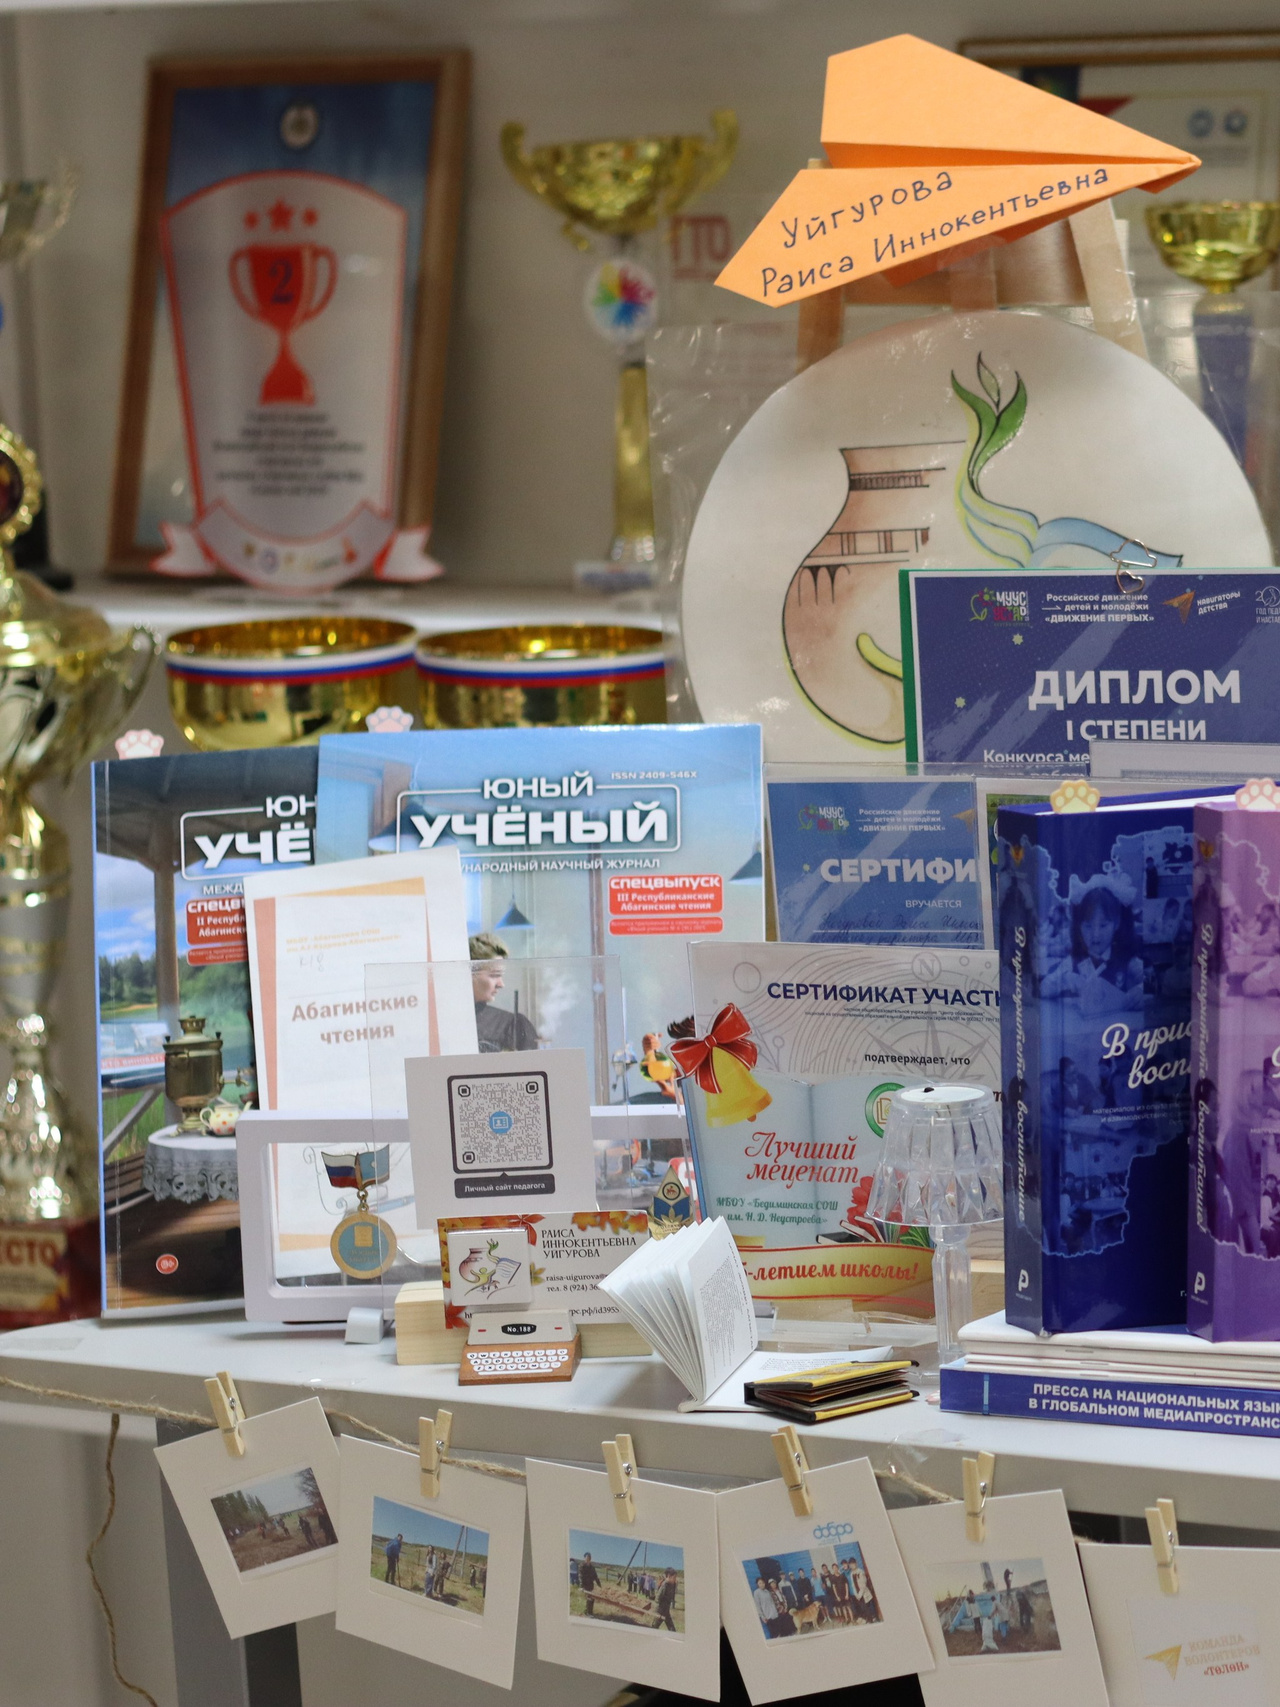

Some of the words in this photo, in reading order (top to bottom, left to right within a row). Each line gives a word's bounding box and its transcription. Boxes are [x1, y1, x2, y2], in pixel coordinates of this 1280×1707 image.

[781, 170, 953, 249] Уйгурова
[761, 252, 855, 298] Раиса
[873, 167, 1109, 263] Иннокентьевна
[269, 259, 293, 305] 2
[1046, 593, 1100, 602] Российское
[1101, 594, 1149, 602] движение
[1064, 603, 1092, 611] детей
[1101, 603, 1149, 611] молодёжи
[1045, 614, 1106, 624] «ДВИЖЕНИЕ
[1107, 613, 1155, 623] ПЕРВЫХ»
[1198, 602, 1229, 615] ДЕТСТВА
[1028, 669, 1241, 711] ДИПЛОМ
[1066, 720, 1074, 741] I
[1080, 719, 1207, 742] СТЕПЕНИ
[983, 749, 1064, 763] Конкурса
[482, 770, 594, 801] ЮНЫЙ
[610, 771, 636, 780] ISSN
[409, 801, 669, 849] УЧЁНЫЙ
[194, 821, 315, 869] УЧЁ
[540, 857, 604, 872] НАУЧНЫЙ
[606, 858, 661, 870] ЖУРНАЛ
[617, 892, 629, 902] III
[631, 892, 715, 903] Республиканские
[620, 902, 676, 911] Абагинские
[678, 902, 712, 910] чтения
[905, 899, 962, 908] ВРУЧАЕТСЯ
[1013, 926, 1027, 948] В
[1200, 923, 1213, 946] В
[766, 982, 919, 1006] СЕРТИФИКАТ
[291, 993, 419, 1022] Абагинские
[1011, 952, 1026, 1083] приоритете
[1198, 948, 1212, 1083] приоритете
[319, 1024, 395, 1045] чтения
[1102, 1023, 1130, 1060] В
[864, 1053, 948, 1066] подтверждает,
[950, 1056, 971, 1066] что
[744, 1130, 859, 1164] Лучший
[1016, 1098, 1030, 1224] воспитание
[746, 1163, 859, 1189] меценат
[464, 1184, 494, 1193] Личный
[513, 1182, 546, 1190] педагога
[716, 1197, 746, 1207] МБОУ
[815, 1200, 839, 1210] СОШ
[727, 1213, 744, 1221] им.
[746, 1212, 757, 1221] Н.
[757, 1212, 768, 1222] Д.
[541, 1228, 575, 1239] РАИСА
[542, 1237, 637, 1249] ИННОКЕНТЬЕВНА
[840, 1262, 919, 1281] школы!
[569, 1284, 588, 1292] (924)
[1032, 1382, 1090, 1399] ПРЕССА
[1091, 1386, 1113, 1401] НА
[1115, 1388, 1240, 1411] НАЦИОНАЛЬНЫХ
[1028, 1398, 1038, 1410] В
[1040, 1399, 1141, 1419] ГЛОБАЛЬНОМ
